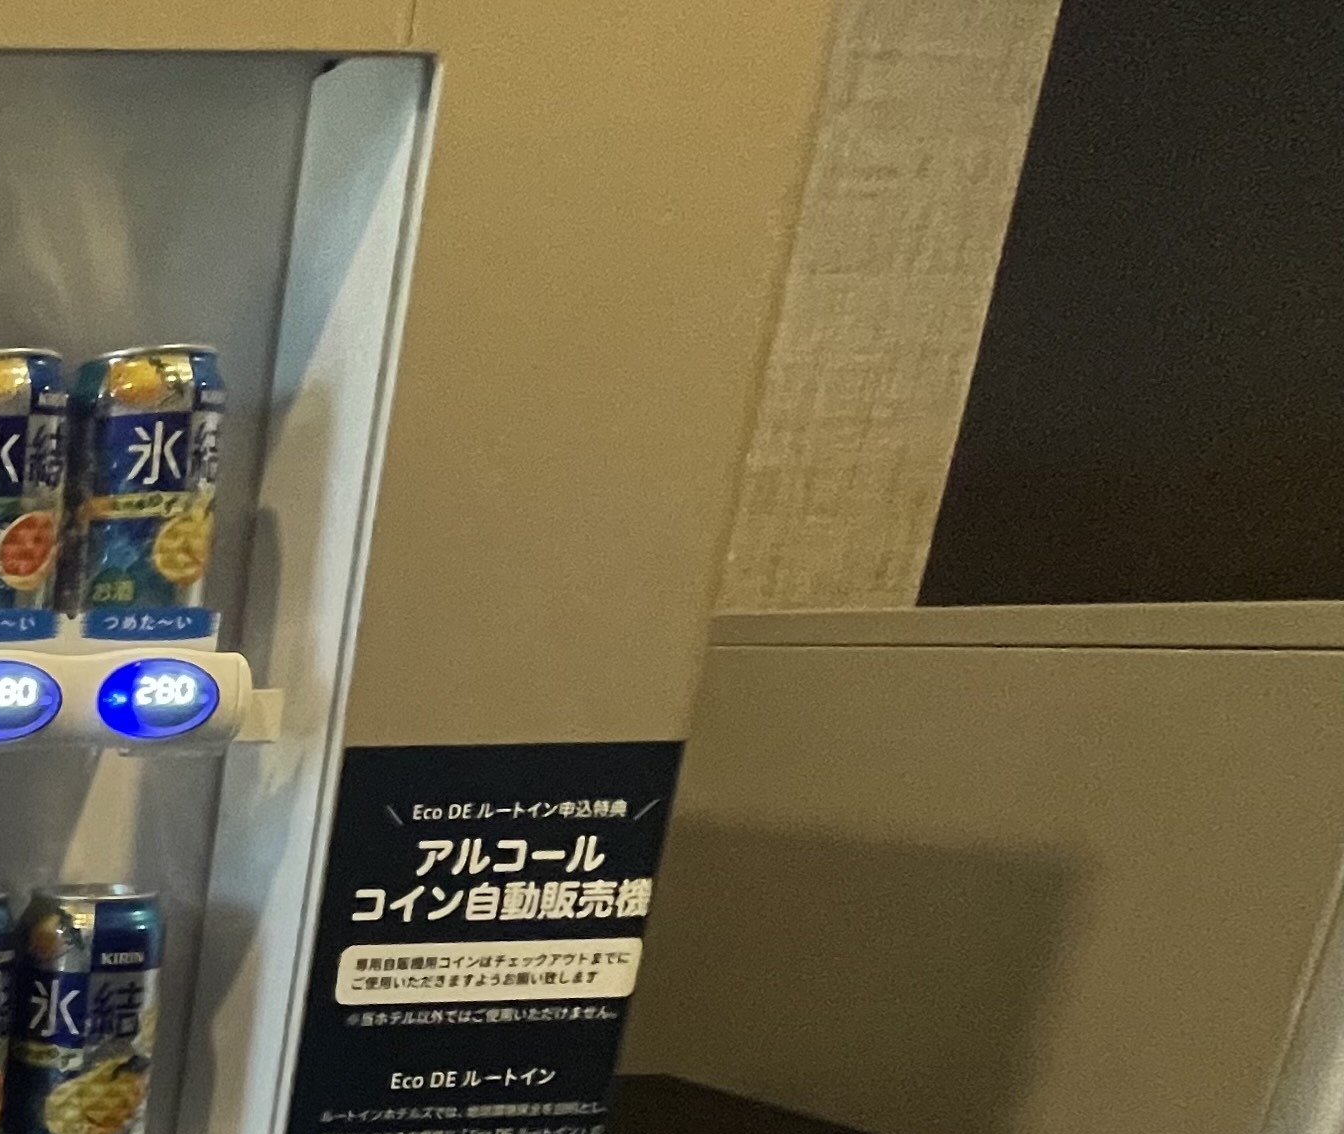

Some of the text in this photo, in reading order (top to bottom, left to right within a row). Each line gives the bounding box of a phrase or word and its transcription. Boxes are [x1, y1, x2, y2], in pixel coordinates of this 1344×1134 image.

[136, 675, 196, 705] 280
[412, 800, 628, 821] Eco DE ルートイン申込特典
[416, 835, 605, 876] アルコール
[351, 878, 653, 922] コイン自動販売機
[101, 952, 144, 965] KIRIN
[390, 1068, 556, 1090] Eco DE ルートイン
